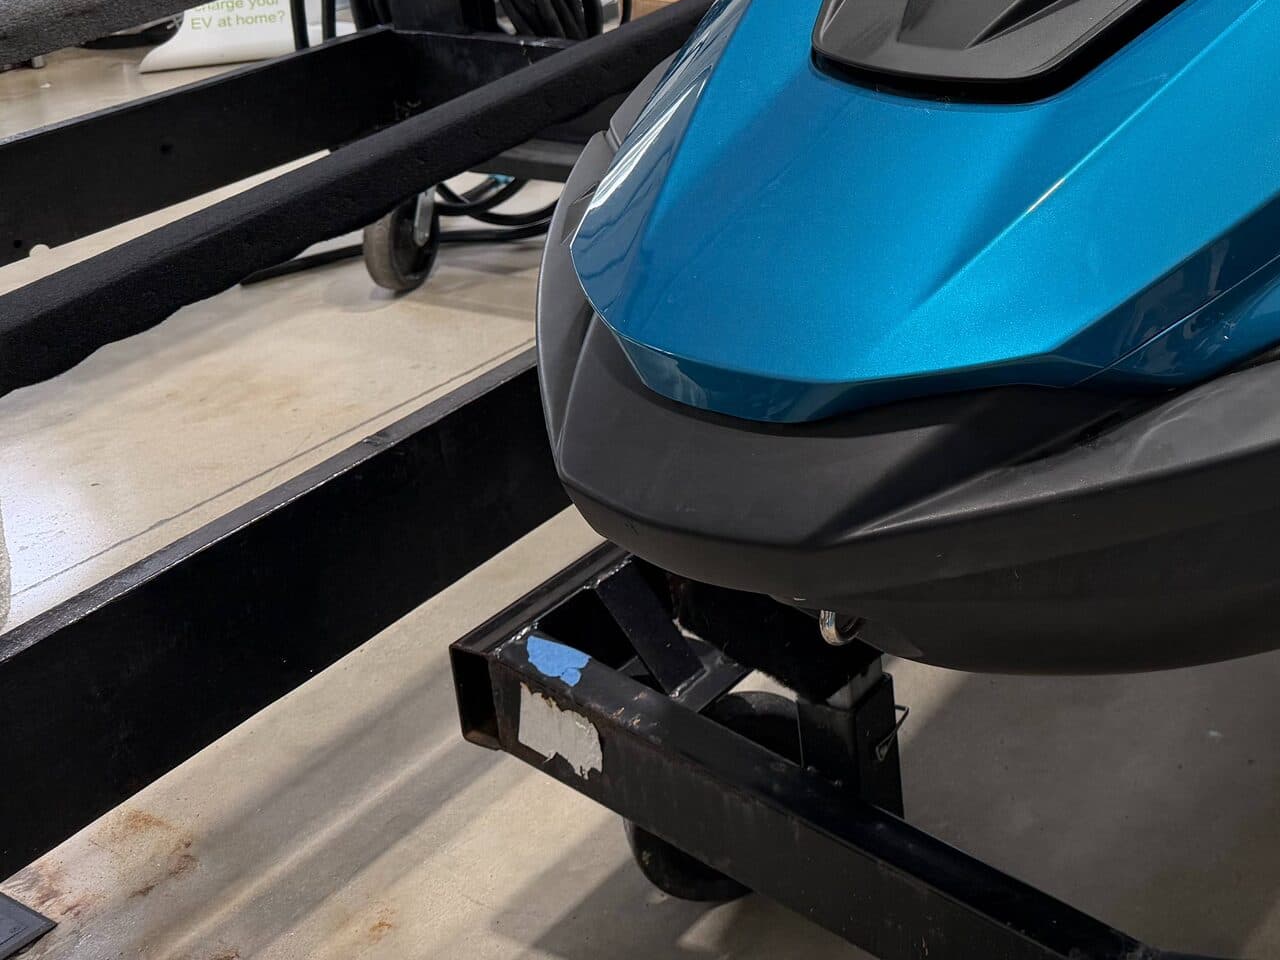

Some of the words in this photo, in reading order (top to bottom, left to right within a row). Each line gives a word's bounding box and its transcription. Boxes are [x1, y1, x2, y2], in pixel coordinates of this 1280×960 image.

[191, 16, 213, 30] EV
[218, 16, 232, 28] at
[236, 10, 286, 25] home?
